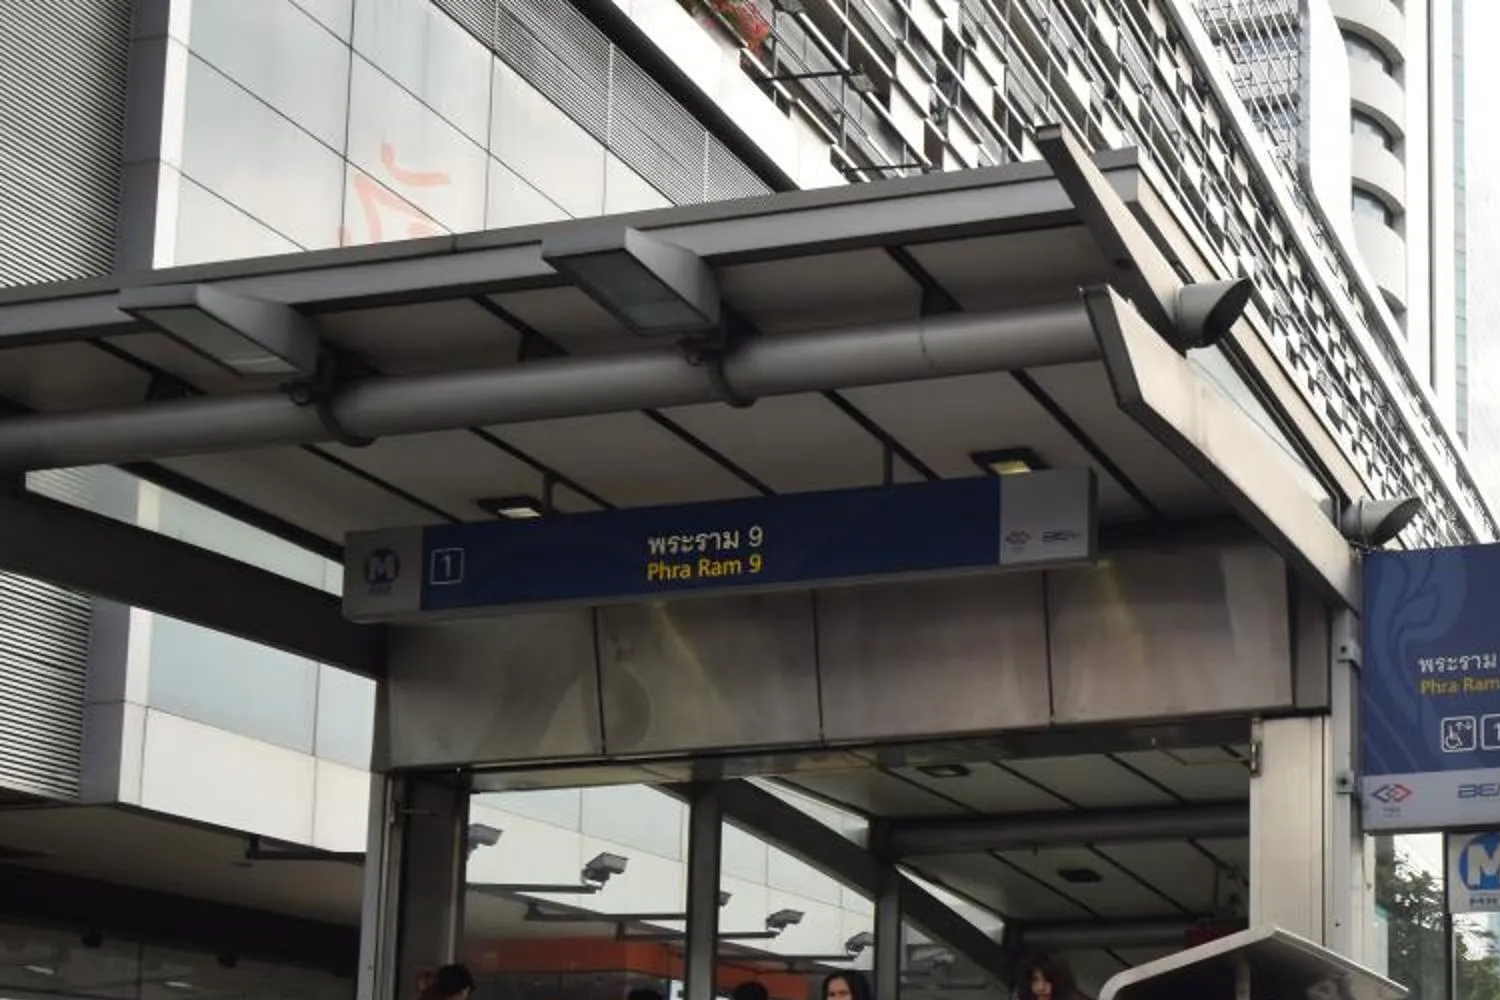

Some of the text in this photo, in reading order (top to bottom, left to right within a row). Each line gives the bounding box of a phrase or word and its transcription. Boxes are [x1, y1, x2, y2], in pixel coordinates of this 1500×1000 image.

[647, 526, 763, 555] พระราม 9
[441, 555, 451, 578] 1
[647, 553, 762, 581] Phra Ram 9
[1418, 653, 1498, 673] พระราม
[1421, 679, 1457, 695] Phra
[1463, 676, 1500, 692] Ram
